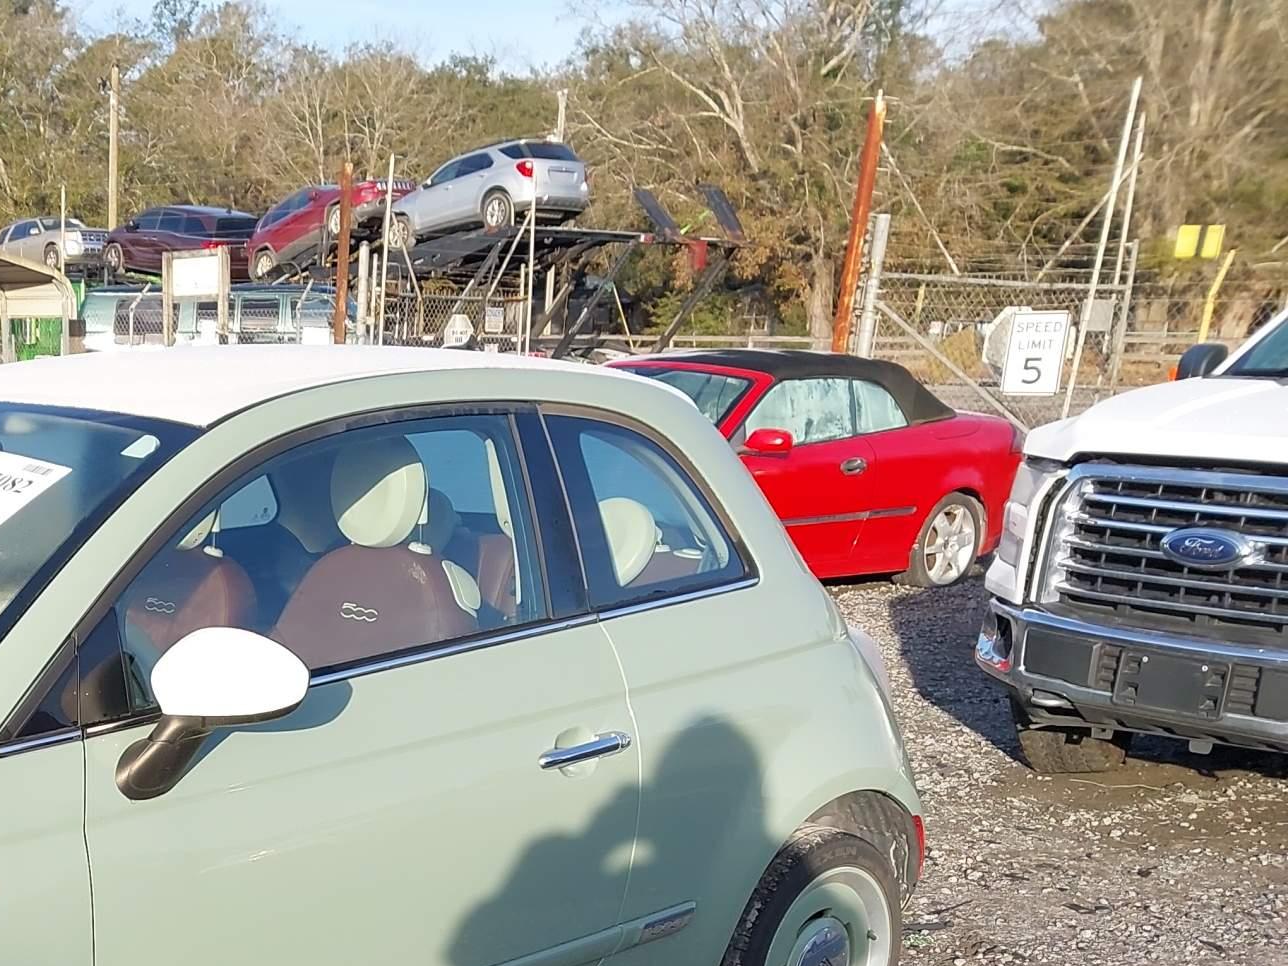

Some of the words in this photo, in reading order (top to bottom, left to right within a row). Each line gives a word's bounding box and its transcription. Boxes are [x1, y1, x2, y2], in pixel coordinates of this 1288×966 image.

[1016, 321, 1063, 333] SPEED
[1018, 339, 1054, 350] LIMIT
[1021, 357, 1043, 384] 5
[1179, 536, 1225, 558] Ford
